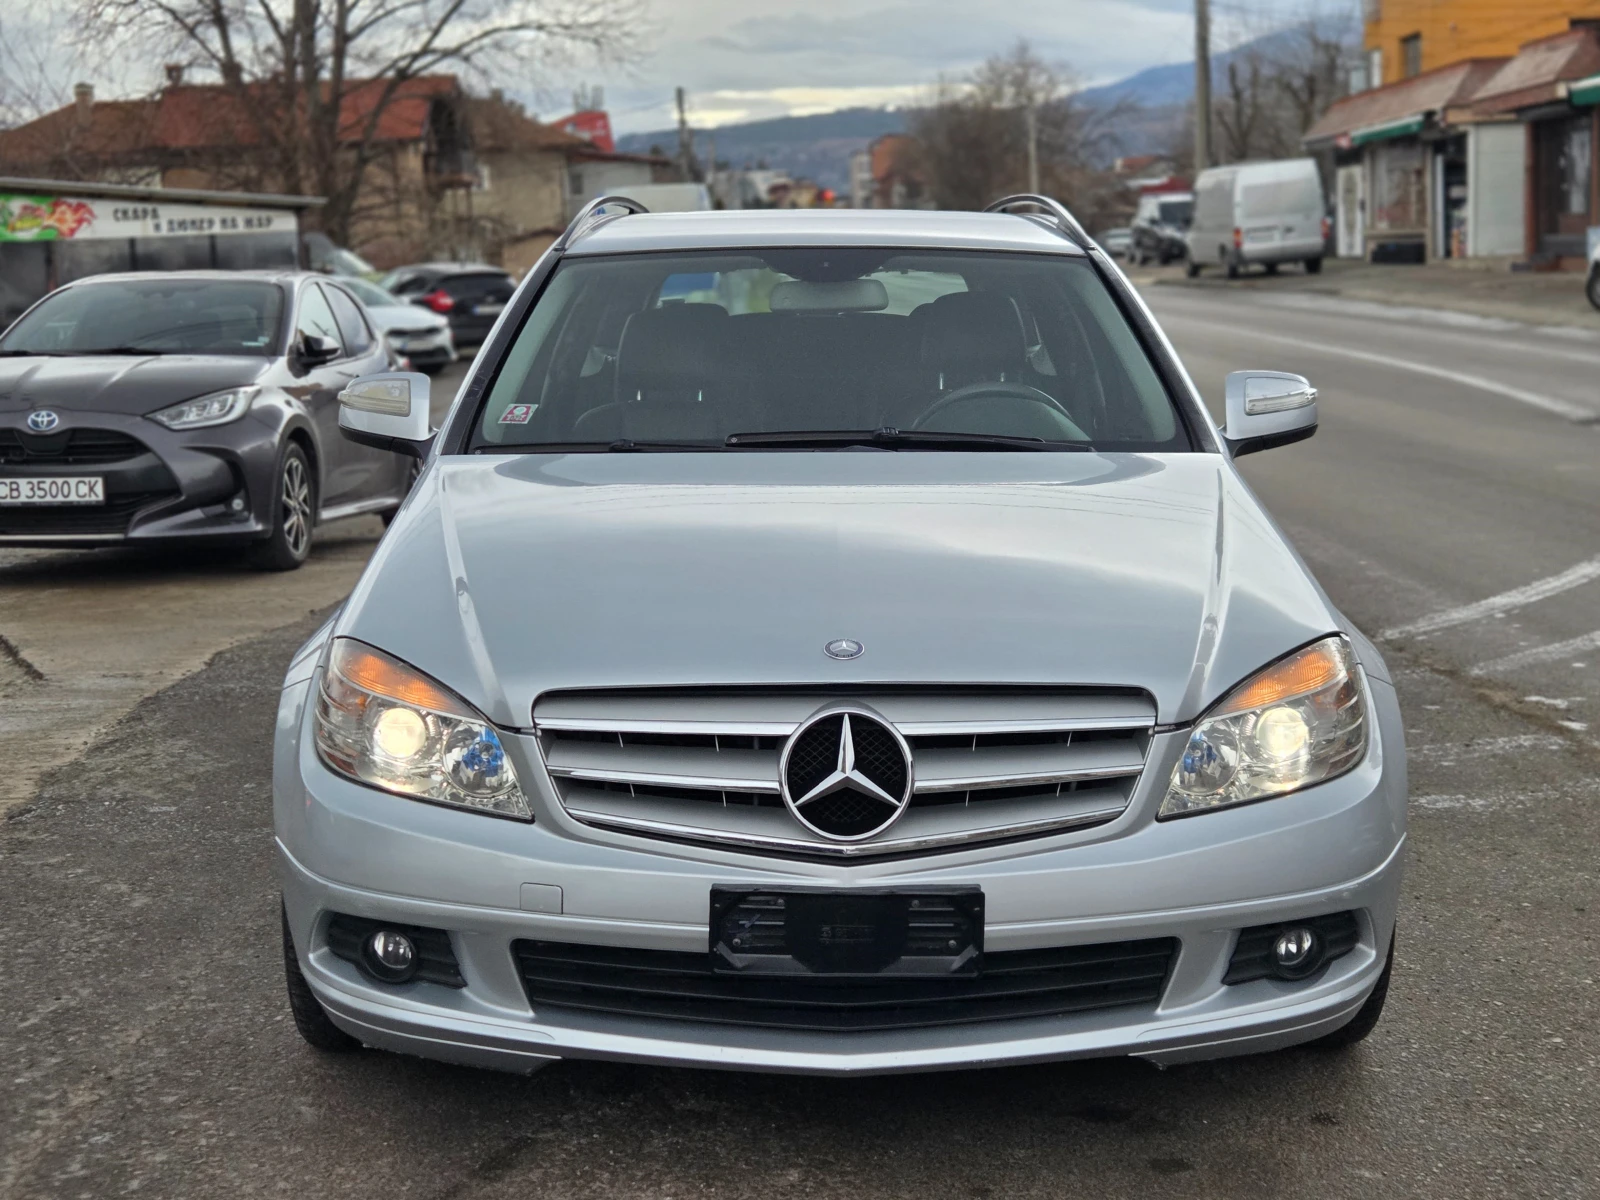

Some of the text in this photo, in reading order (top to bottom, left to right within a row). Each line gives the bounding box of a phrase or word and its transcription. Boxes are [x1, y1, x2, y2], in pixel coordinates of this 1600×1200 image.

[113, 207, 159, 222] СКАРА
[0, 480, 99, 499] CB 3500 CK
